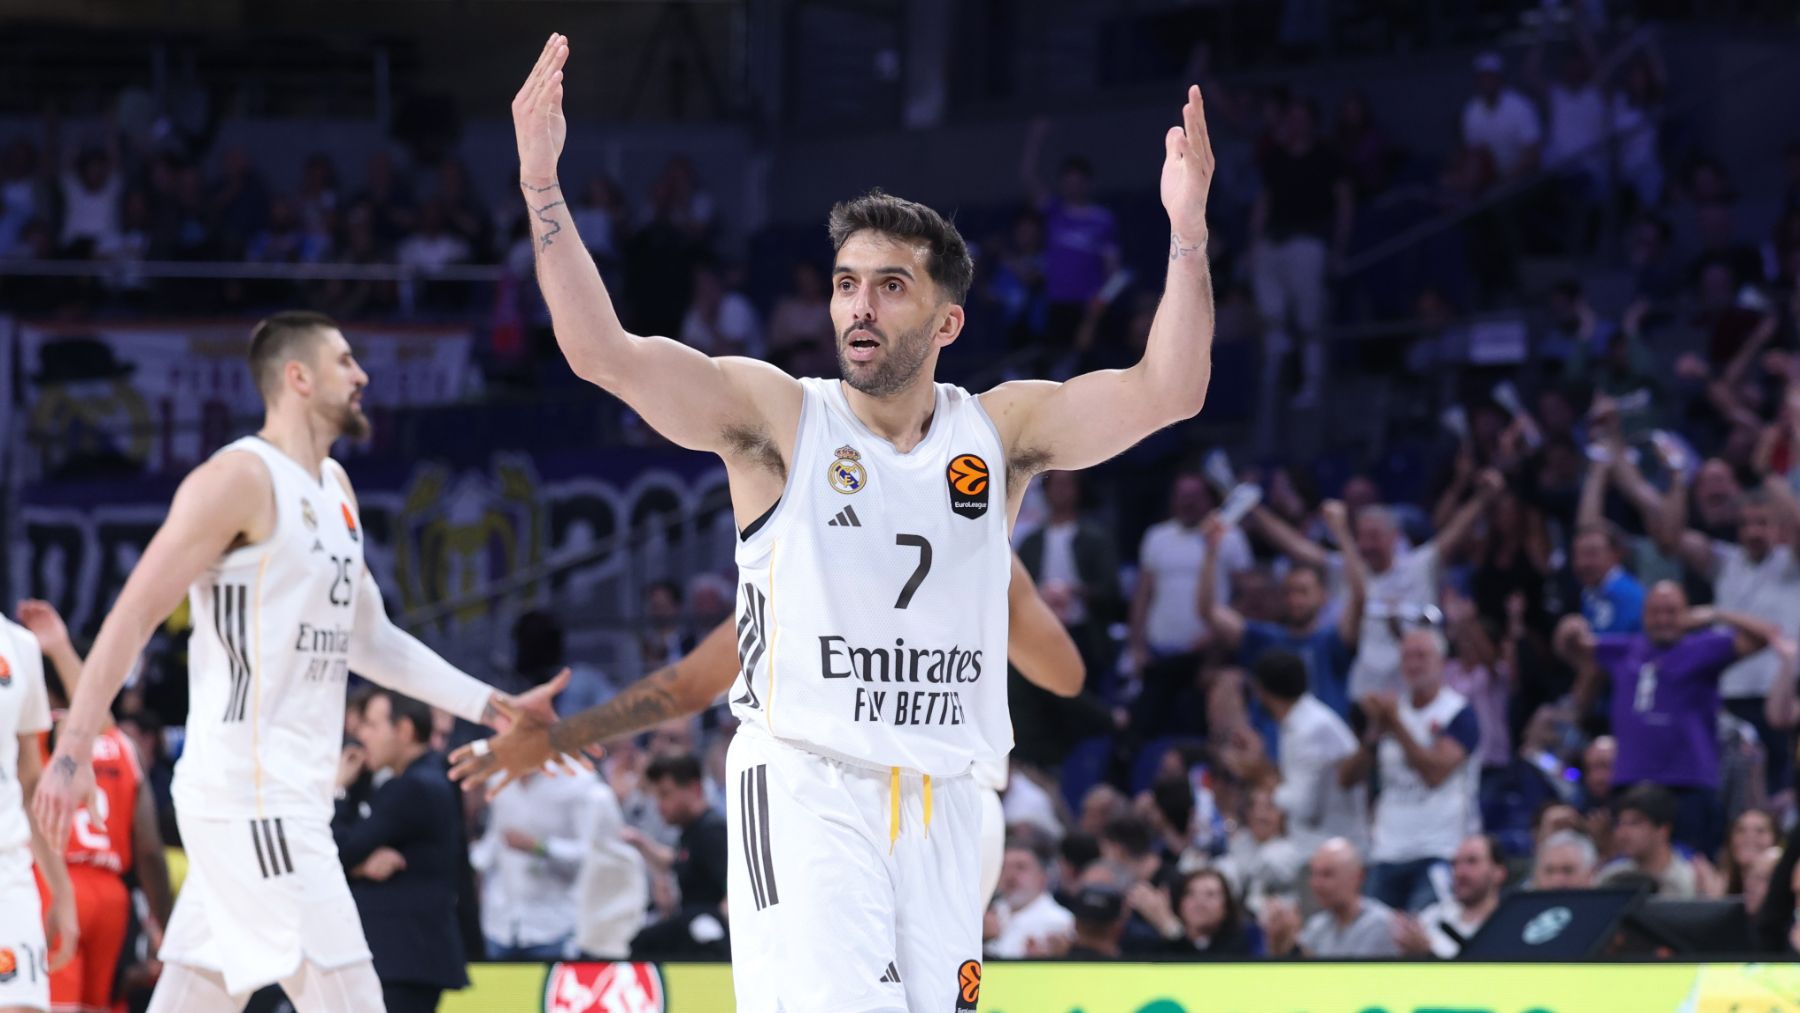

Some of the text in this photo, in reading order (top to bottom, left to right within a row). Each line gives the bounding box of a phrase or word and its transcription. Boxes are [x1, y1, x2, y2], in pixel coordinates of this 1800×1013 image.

[329, 555, 352, 606] 25
[894, 533, 933, 610] 7
[818, 635, 983, 683] Emirates
[854, 687, 886, 722] FLY
